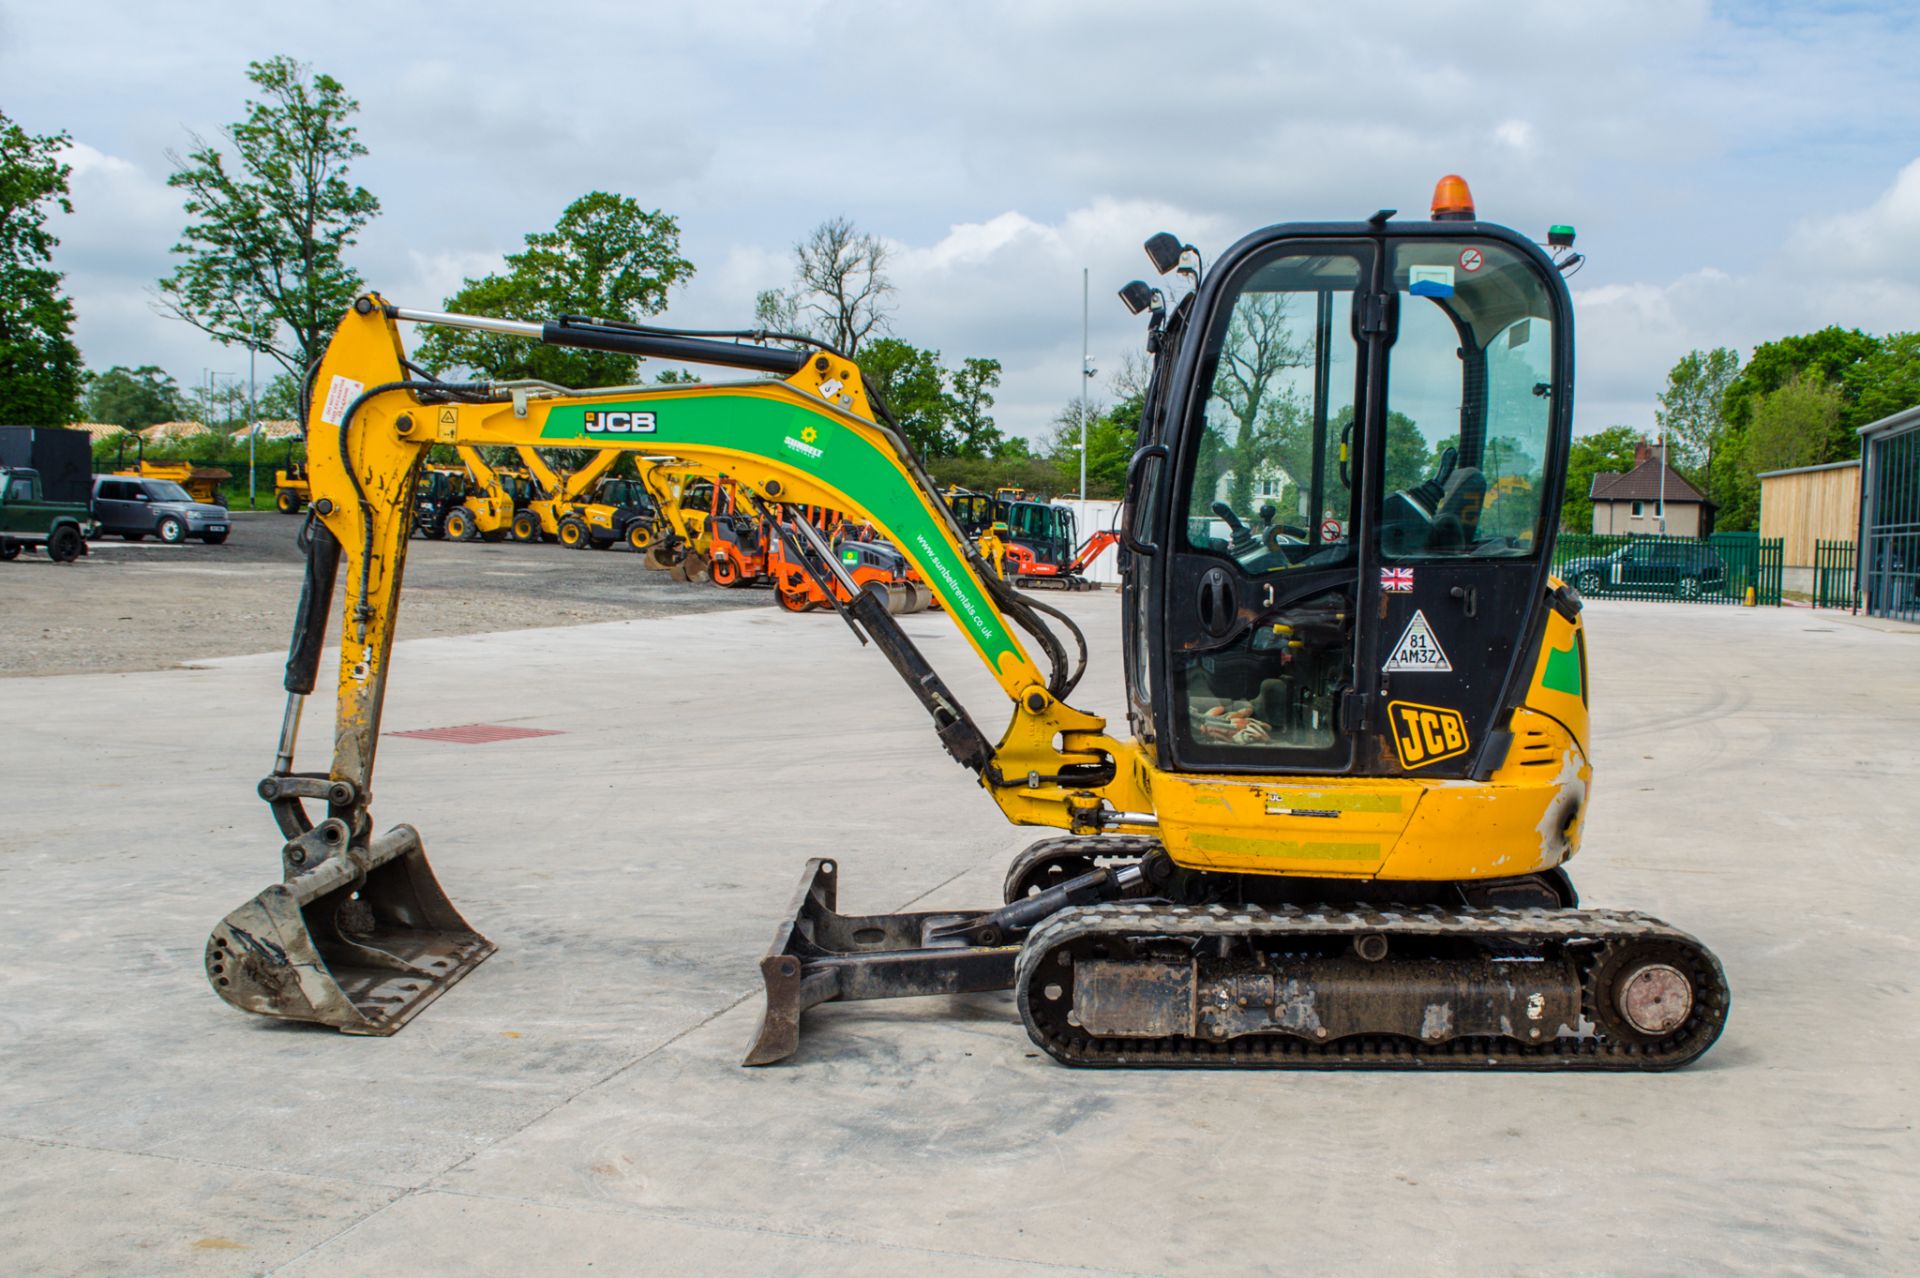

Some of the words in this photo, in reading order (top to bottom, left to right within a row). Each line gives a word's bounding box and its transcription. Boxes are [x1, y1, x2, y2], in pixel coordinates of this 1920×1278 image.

[585, 412, 656, 432] JCB
[916, 534, 993, 640] www.sunbeltrentals.co.uk
[1410, 634, 1427, 648] 81
[1400, 649, 1436, 663] AM3Z
[1401, 708, 1463, 762] JCB
